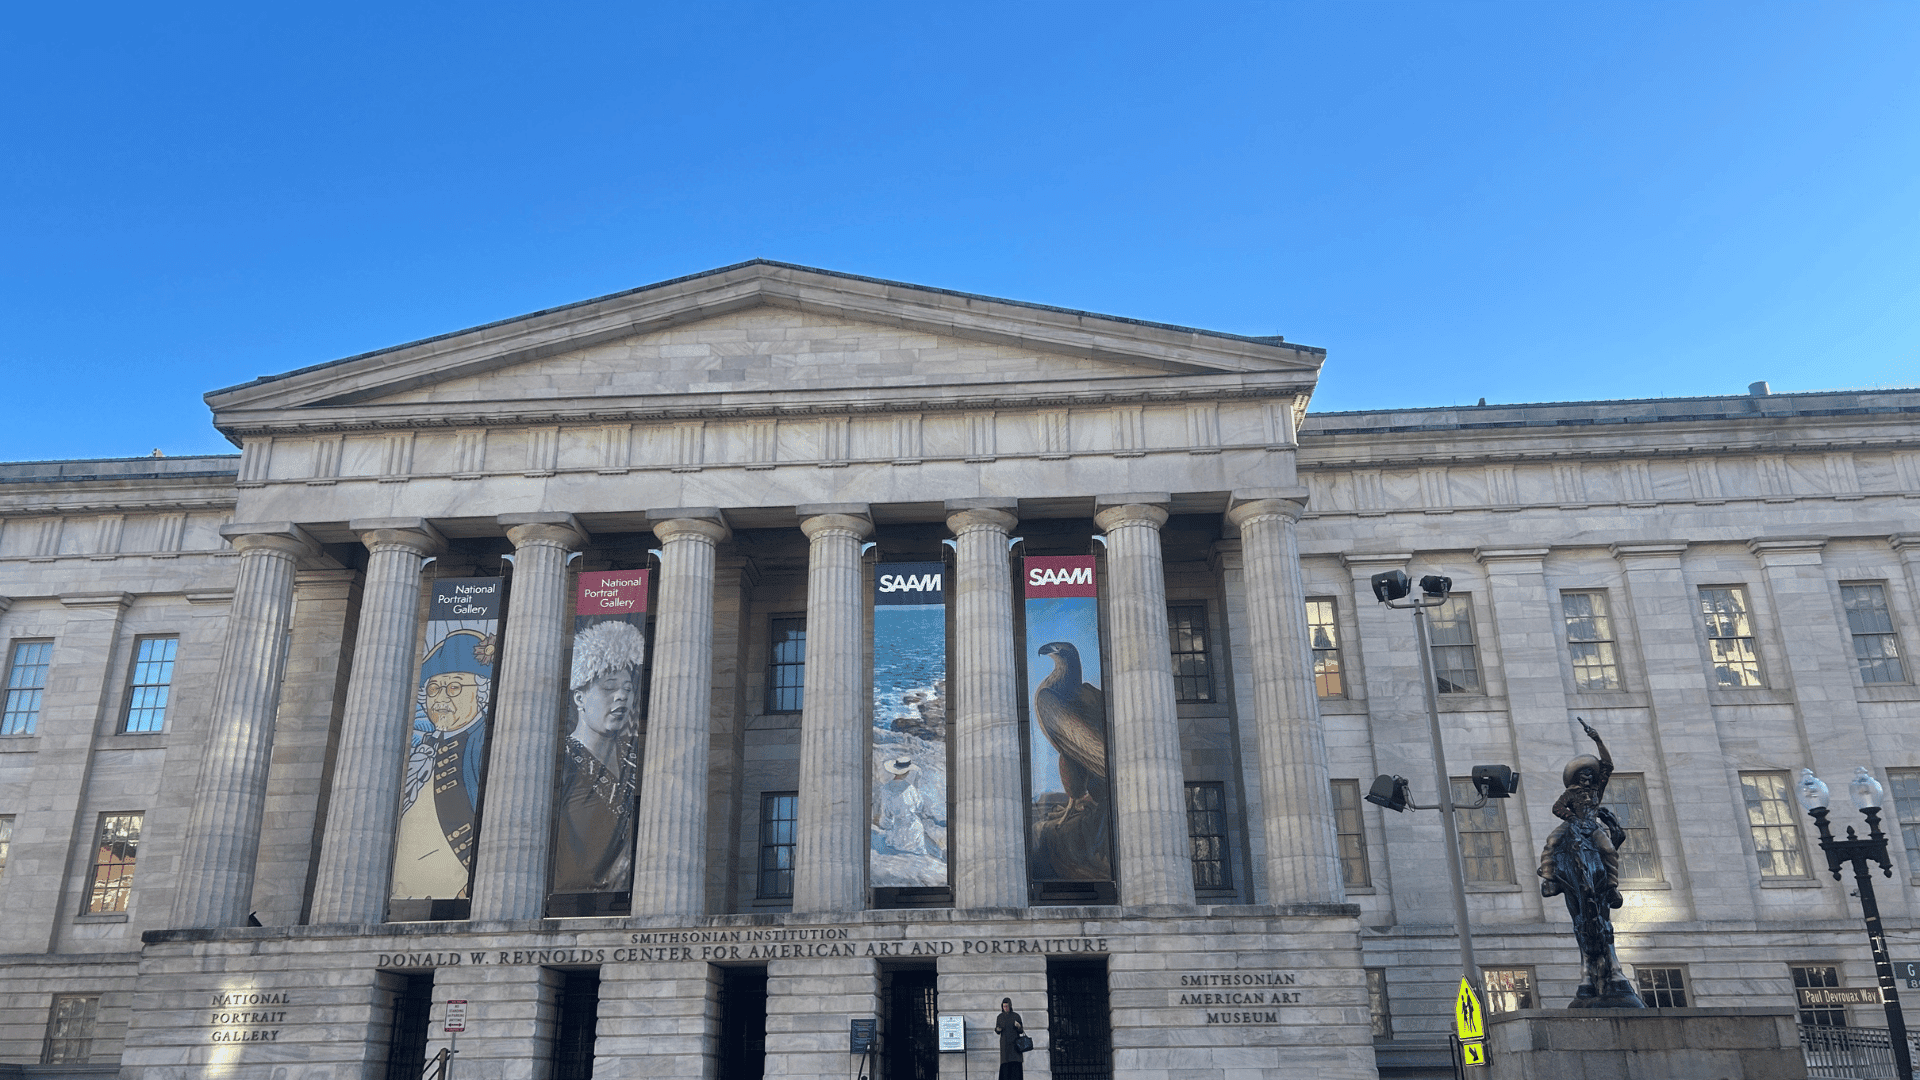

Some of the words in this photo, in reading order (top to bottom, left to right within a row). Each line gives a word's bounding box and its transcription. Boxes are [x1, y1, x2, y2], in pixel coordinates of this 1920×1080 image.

[601, 577, 642, 588] National
[878, 573, 942, 592] SAAM
[1028, 568, 1093, 586] SAAM
[455, 583, 496, 594] National
[584, 588, 619, 598] Portrait
[438, 594, 473, 604] Portrait
[600, 597, 635, 609] Gallery
[453, 604, 488, 616] Gallery
[631, 930, 741, 944] SMITHSONIAN
[747, 928, 849, 941] INSTITUTION
[378, 952, 461, 968] DONALD
[470, 951, 489, 966] W.
[499, 949, 605, 965] REYNOLDS
[613, 945, 693, 962] CENTER
[702, 946, 742, 960] FOR
[748, 943, 856, 959] AMERICAN
[864, 941, 904, 956] ART
[910, 941, 954, 955] AND
[962, 938, 1109, 957] PORTRAITURE
[1907, 963, 1915, 977] G
[1181, 973, 1295, 986] SMITHSONIAN
[211, 993, 291, 1006] NATIONAL
[1180, 992, 1265, 1005] AMERICAN
[1271, 992, 1302, 1004] ART
[1804, 990, 1823, 1003] Paul
[1824, 990, 1860, 1003] Devrouax
[1860, 988, 1877, 1004] Way
[211, 1011, 287, 1024] PORTRAIT
[1207, 1012, 1278, 1024] MUSEUM
[212, 1030, 280, 1042] GALLERY
